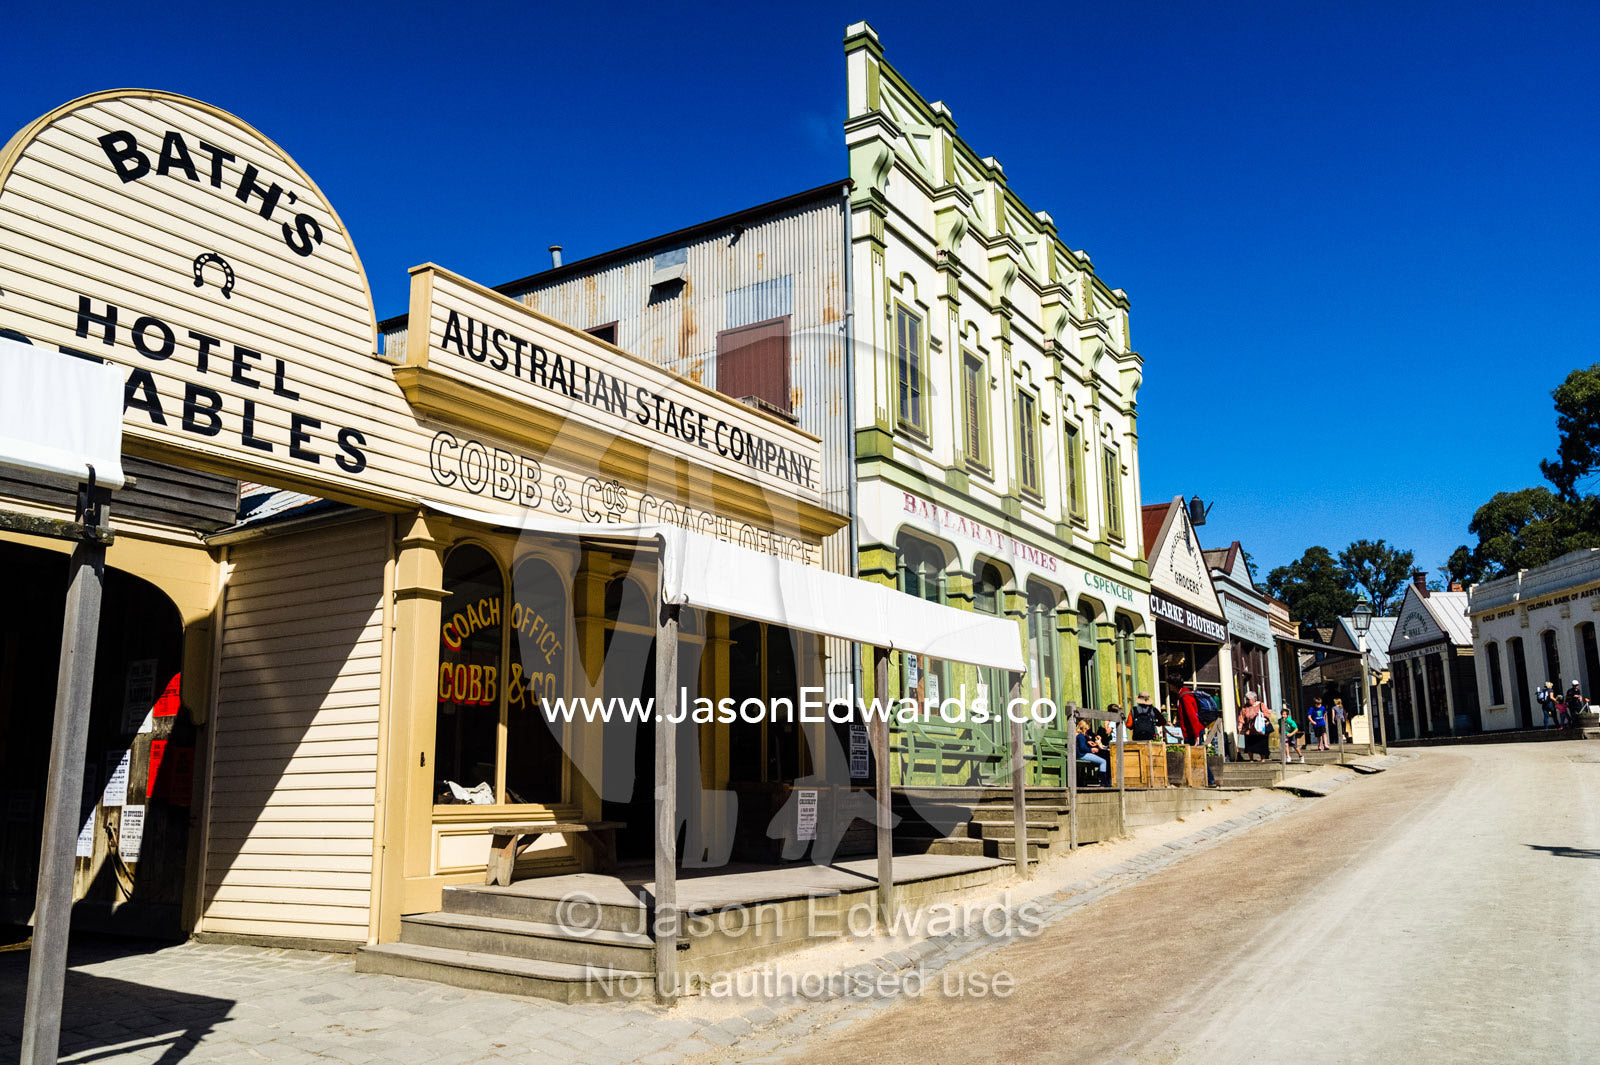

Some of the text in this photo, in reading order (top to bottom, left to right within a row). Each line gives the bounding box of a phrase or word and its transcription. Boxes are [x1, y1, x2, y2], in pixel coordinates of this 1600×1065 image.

[98, 130, 323, 257] BATH'S
[76, 295, 300, 401] HOTEL
[441, 310, 815, 489] AUSTRALIAN STAGE COMPANY.
[430, 431, 543, 508] COBB
[551, 475, 572, 514] &
[902, 491, 1057, 572] BALLARAT TIMES
[1174, 571, 1199, 595] GROCERS
[1482, 609, 1515, 623] GOLD OFFICE
[1527, 600, 1553, 611] COLONIAL
[1555, 595, 1571, 605] BANK
[1571, 592, 1579, 600] OF
[442, 597, 562, 664] COACH OFFICE
[1150, 595, 1184, 624] CLARKE
[1186, 611, 1225, 641] BROTHERS
[438, 661, 556, 710] COBB & CO
